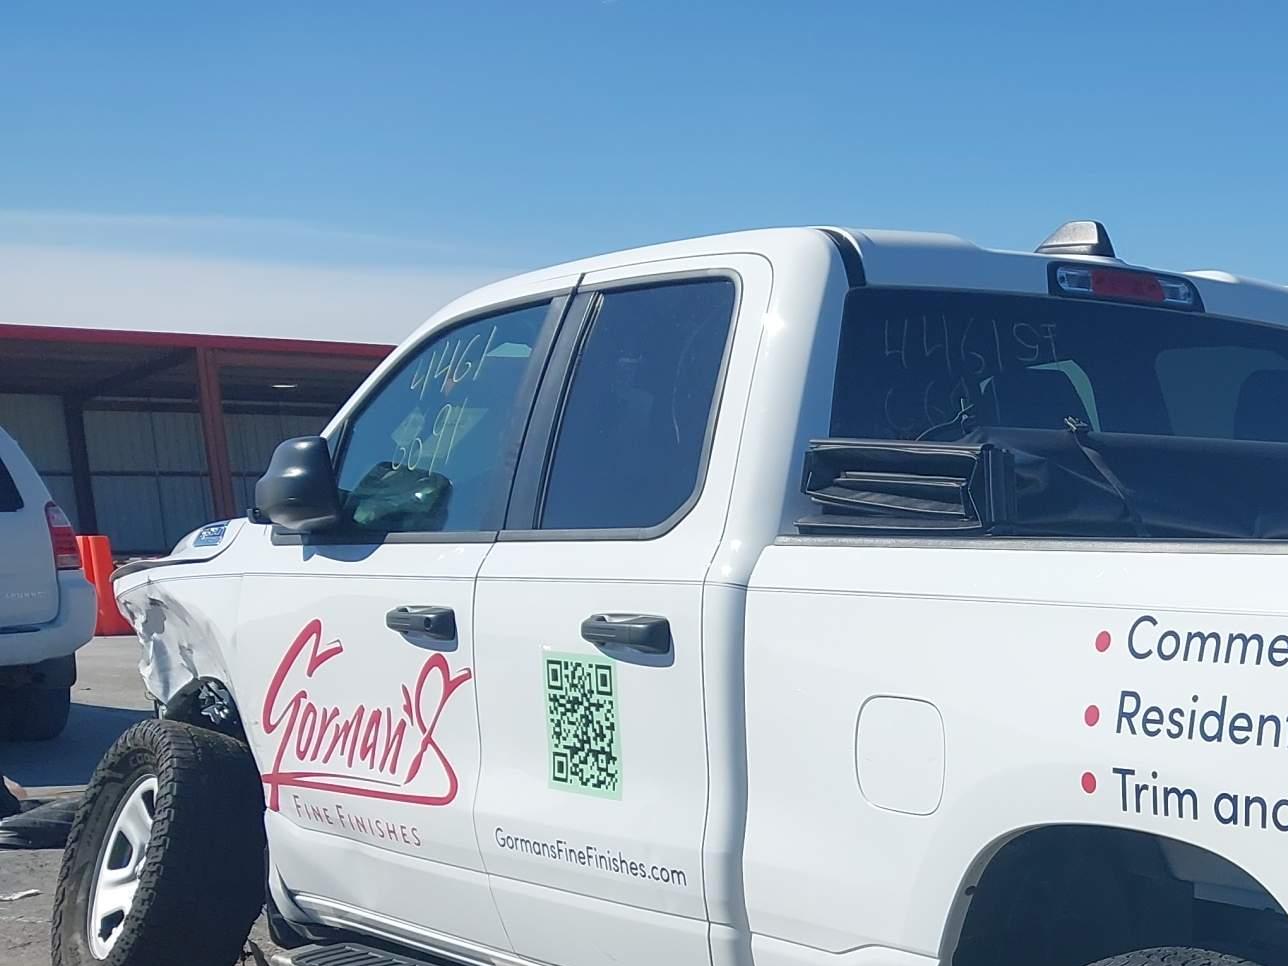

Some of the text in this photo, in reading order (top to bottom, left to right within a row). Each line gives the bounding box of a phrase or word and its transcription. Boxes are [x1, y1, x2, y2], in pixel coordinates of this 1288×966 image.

[410, 325, 498, 401] 4461
[292, 794, 422, 847] FINE FINISHES
[1111, 767, 1199, 821] Trim
[494, 827, 688, 887] GormansFineFinishes.com
